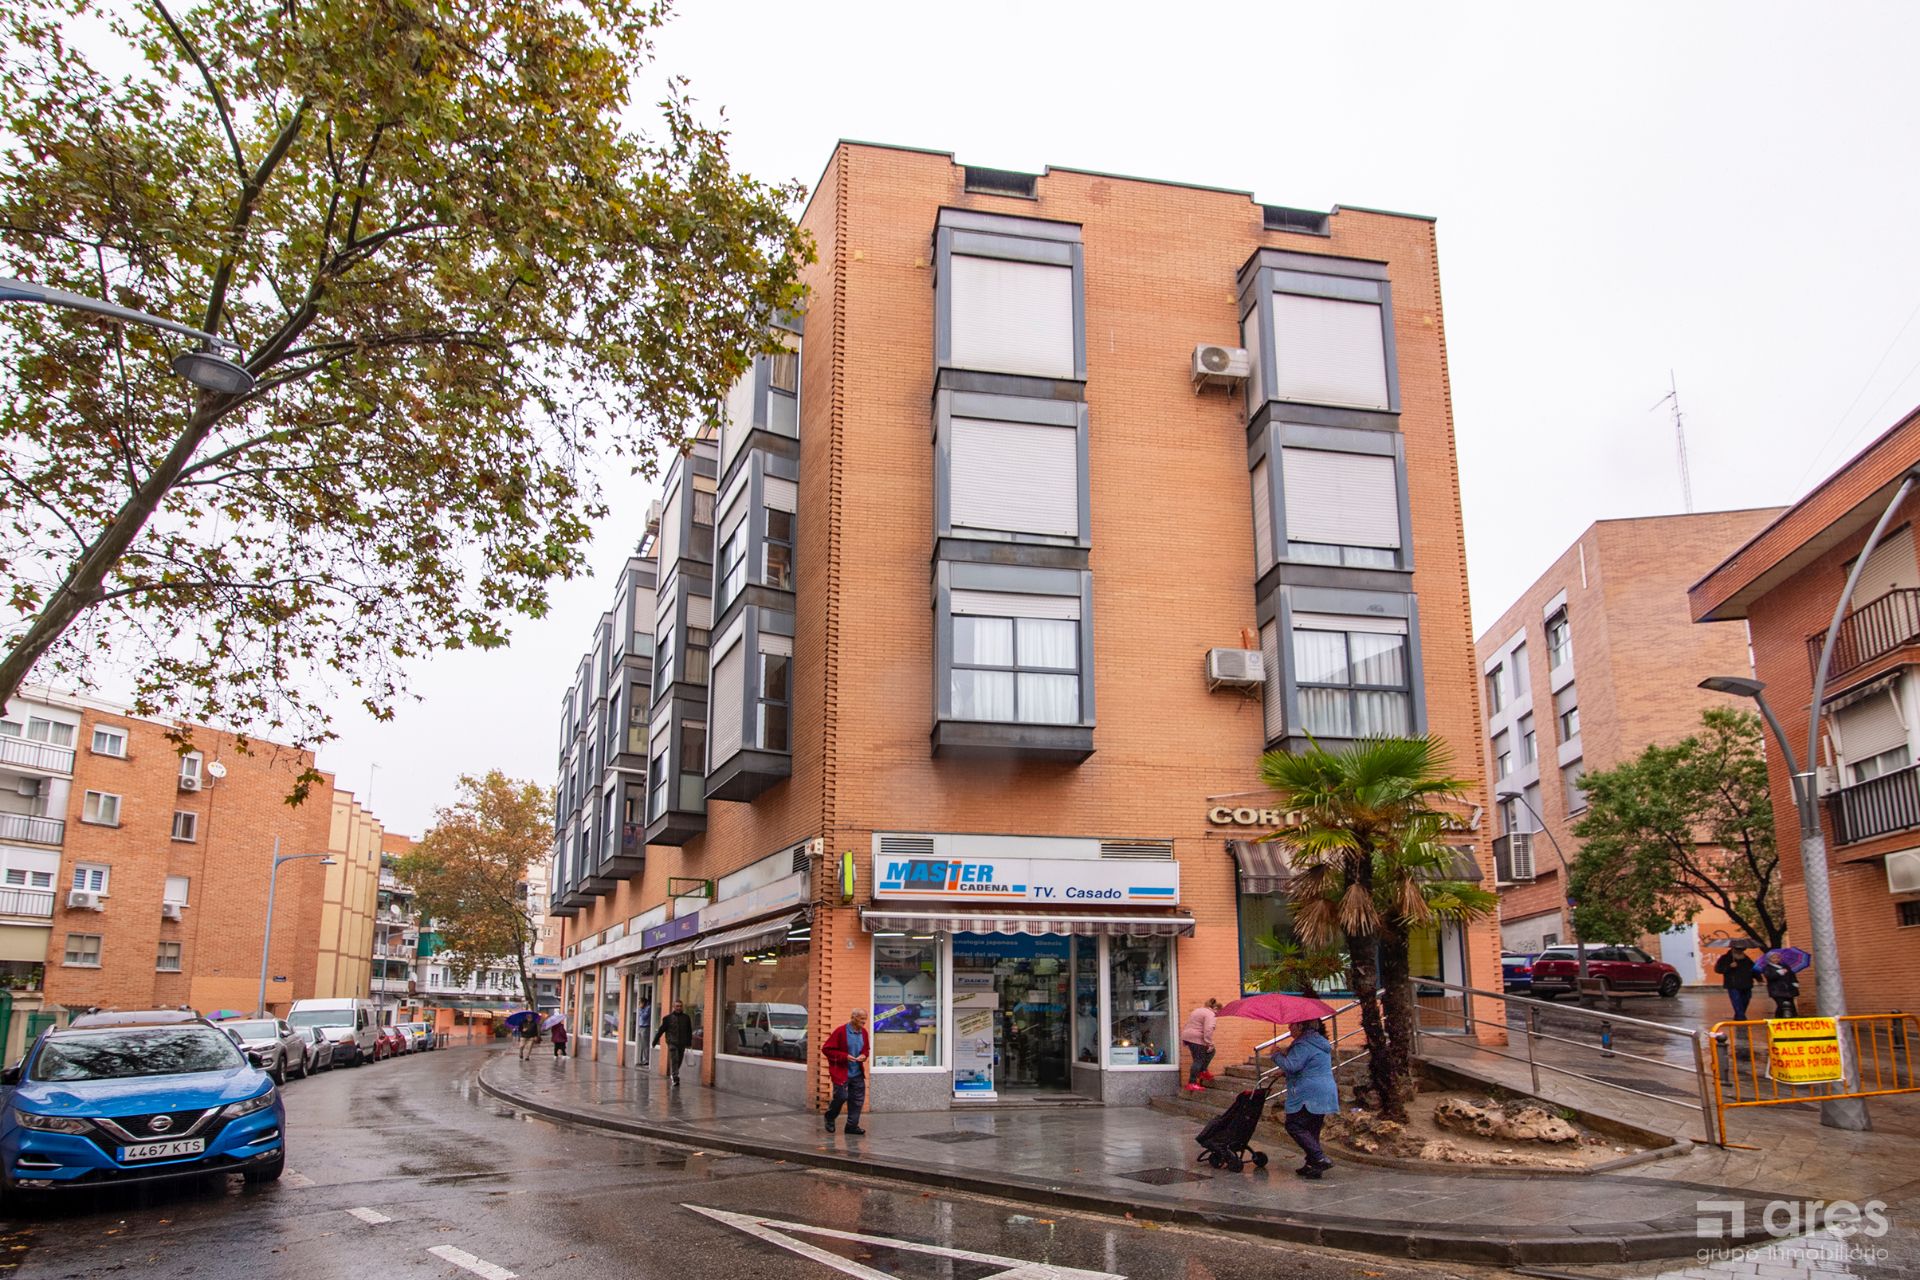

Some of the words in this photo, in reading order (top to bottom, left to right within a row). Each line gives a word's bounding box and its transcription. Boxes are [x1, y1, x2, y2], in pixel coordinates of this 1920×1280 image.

[886, 862, 993, 883] MASTER
[960, 884, 1009, 892] CADENA
[1034, 887, 1056, 898] TV.
[1066, 887, 1122, 899] Casado
[1772, 1046, 1804, 1056] CALLE
[128, 1145, 168, 1158] 4467
[171, 1141, 201, 1154] KTS
